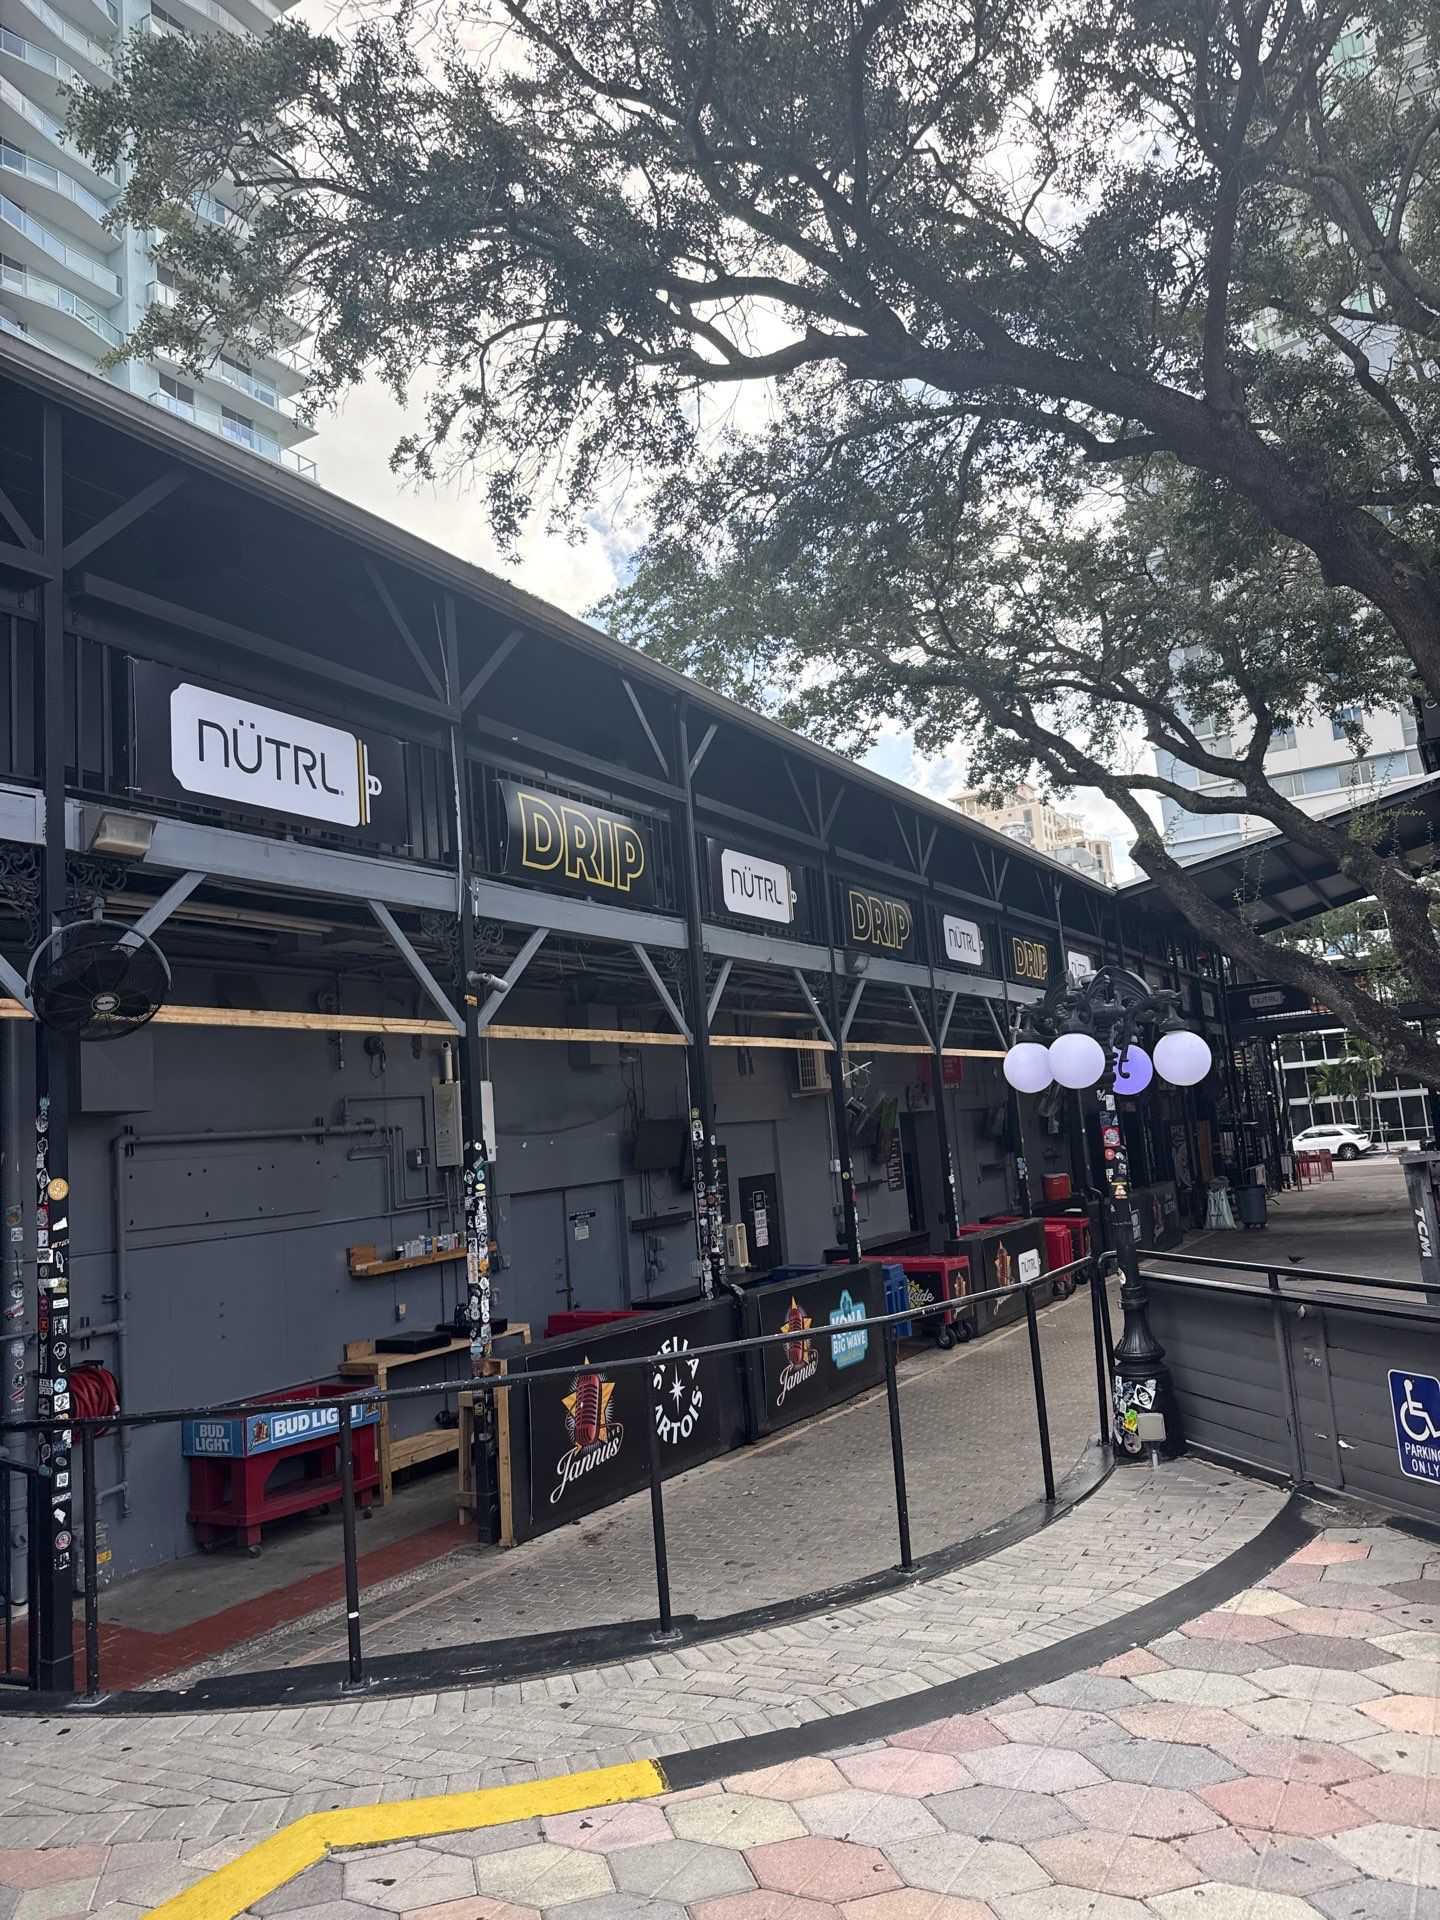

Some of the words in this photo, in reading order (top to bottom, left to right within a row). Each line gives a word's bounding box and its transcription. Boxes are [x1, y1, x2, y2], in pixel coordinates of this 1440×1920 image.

[518, 792, 645, 891] DRIP
[849, 890, 910, 949] DRIP
[1012, 937, 1048, 980] DRIP
[1414, 1206, 1432, 1257] TCM
[833, 1338, 846, 1355] BIG
[846, 1331, 866, 1350] WAVE
[776, 1360, 817, 1407] Jannus
[199, 1424, 225, 1438] BUD
[274, 1413, 311, 1438] BUD
[311, 1404, 358, 1429] LIGT
[195, 1438, 230, 1452] LIGHT
[549, 1437, 620, 1504] Jannus
[1411, 1458, 1440, 1478] ONLY
